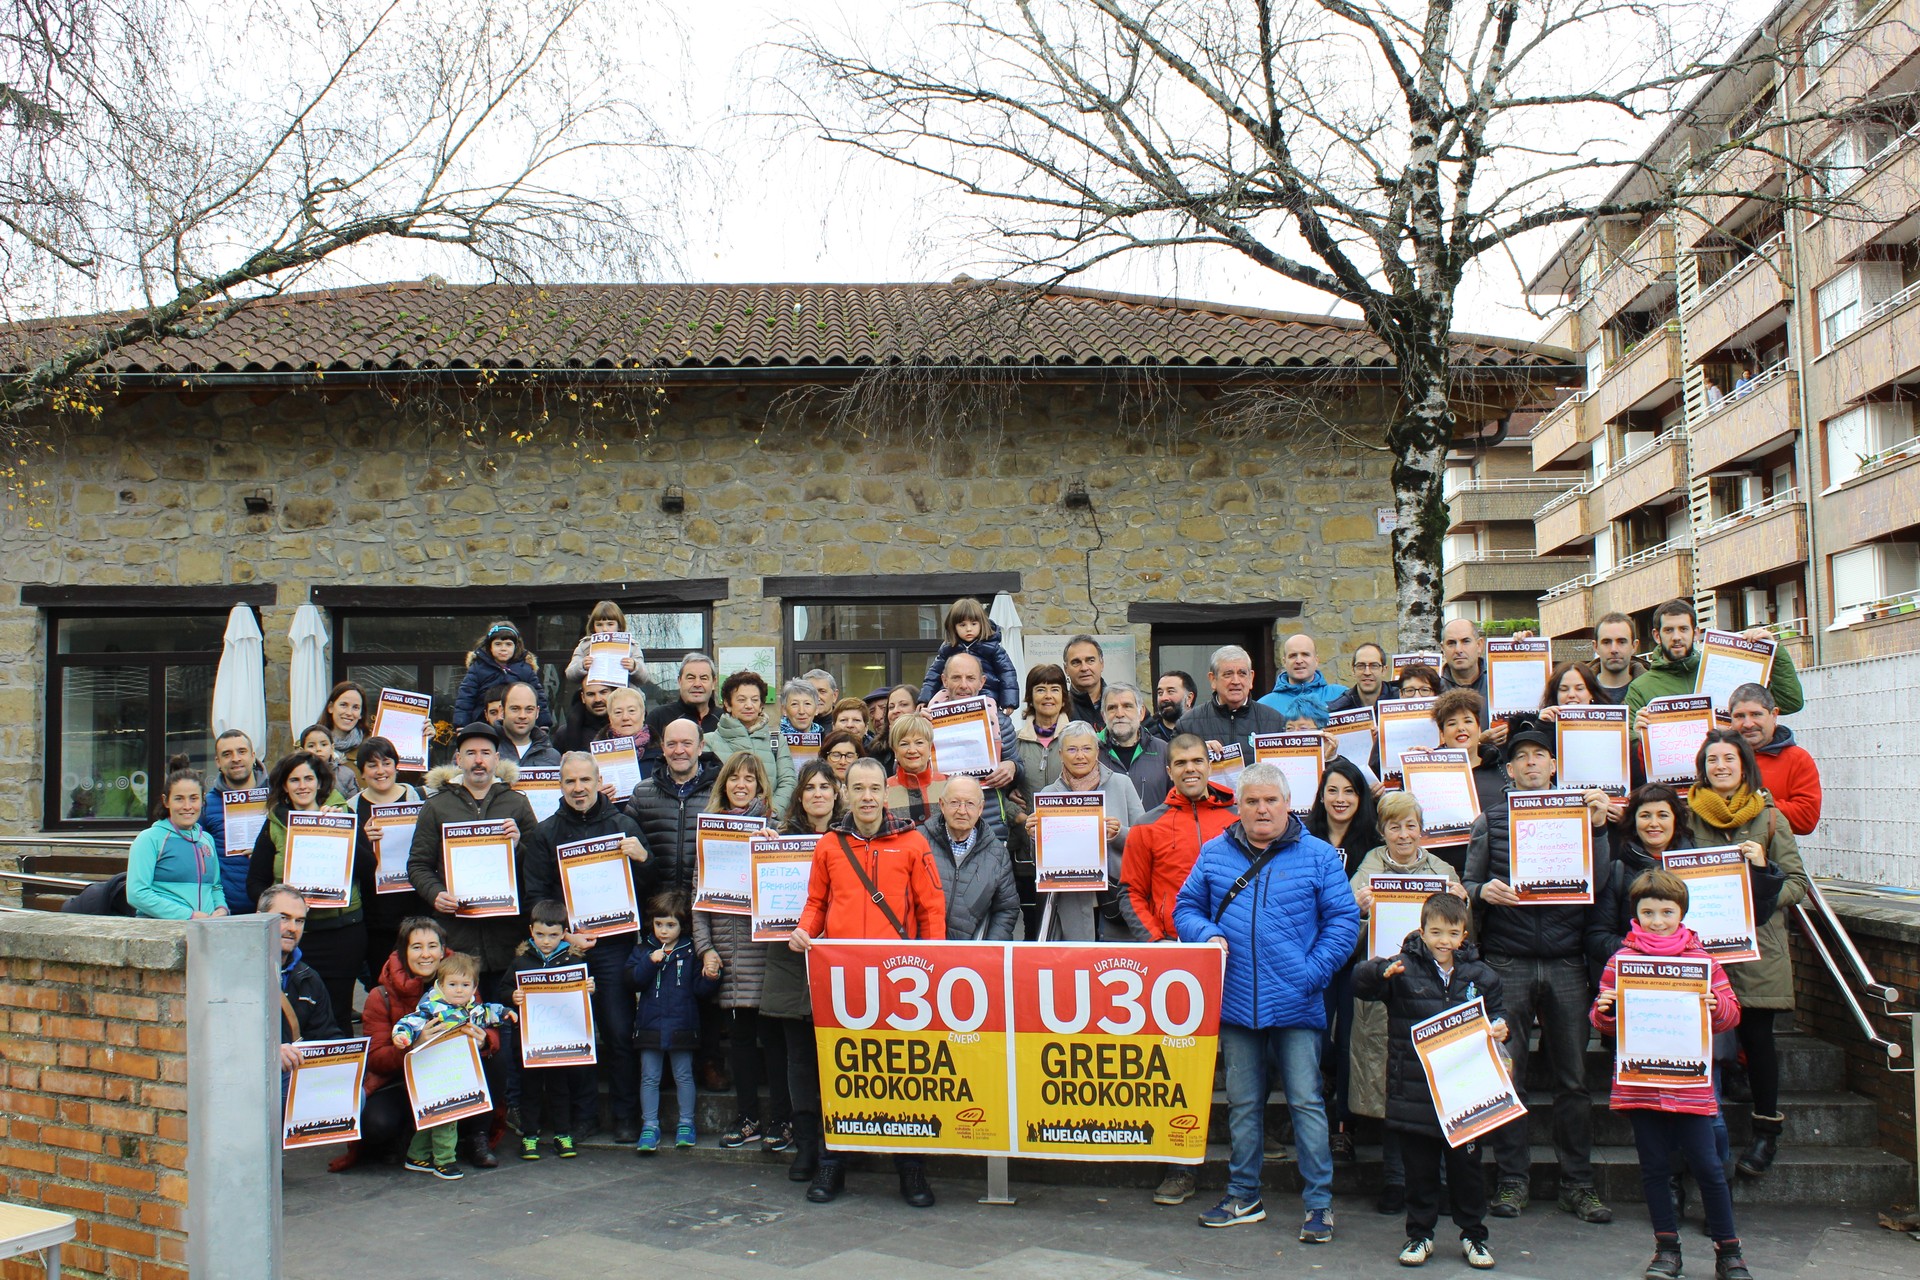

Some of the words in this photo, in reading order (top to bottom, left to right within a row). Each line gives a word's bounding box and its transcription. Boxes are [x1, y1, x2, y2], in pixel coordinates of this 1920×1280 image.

[1709, 636, 1734, 646] DUINA
[1736, 640, 1752, 650] U30
[405, 697, 418, 705] U30
[1672, 702, 1689, 710] U30
[931, 708, 949, 717] UINA
[951, 705, 967, 713] U30
[1652, 724, 1708, 738] ESKUBIDE
[592, 742, 613, 753] U30
[1658, 754, 1695, 766] BERME
[225, 793, 247, 803] U30
[1514, 799, 1541, 808] DUINA
[1545, 797, 1563, 807] U30
[727, 822, 743, 830] U30
[1518, 823, 1536, 840] 50
[562, 847, 586, 857] DUINA
[588, 843, 605, 853] U30
[754, 843, 779, 851] DUINA
[782, 842, 800, 850] U30
[1668, 858, 1698, 868] DUINA
[1700, 855, 1720, 865] U30
[761, 866, 800, 877] BIZITZA
[1405, 882, 1423, 891] U30
[770, 894, 801, 910] EZ
[883, 956, 935, 974] URTARRILA
[1094, 959, 1148, 976] URTARRILA
[1622, 966, 1655, 974] DUINA
[1658, 966, 1681, 976] U30
[549, 974, 566, 982] U30
[830, 966, 988, 1032] U30
[1038, 969, 1204, 1037] U30
[1416, 1025, 1444, 1041] DUINA
[1444, 1014, 1461, 1029] U30
[948, 1032, 980, 1044] ENERO
[1162, 1036, 1196, 1049] ENERO
[327, 1046, 345, 1055] U30
[834, 1037, 957, 1075] GREBA
[1041, 1042, 1171, 1081] GREBA
[834, 1075, 974, 1102] OROKORRA
[1041, 1080, 1188, 1108] OROKORRA
[836, 1120, 882, 1136] HUELGA
[883, 1121, 936, 1138] GENERAL
[1043, 1128, 1087, 1142] HUELGA
[1089, 1129, 1148, 1144] GENERAL
